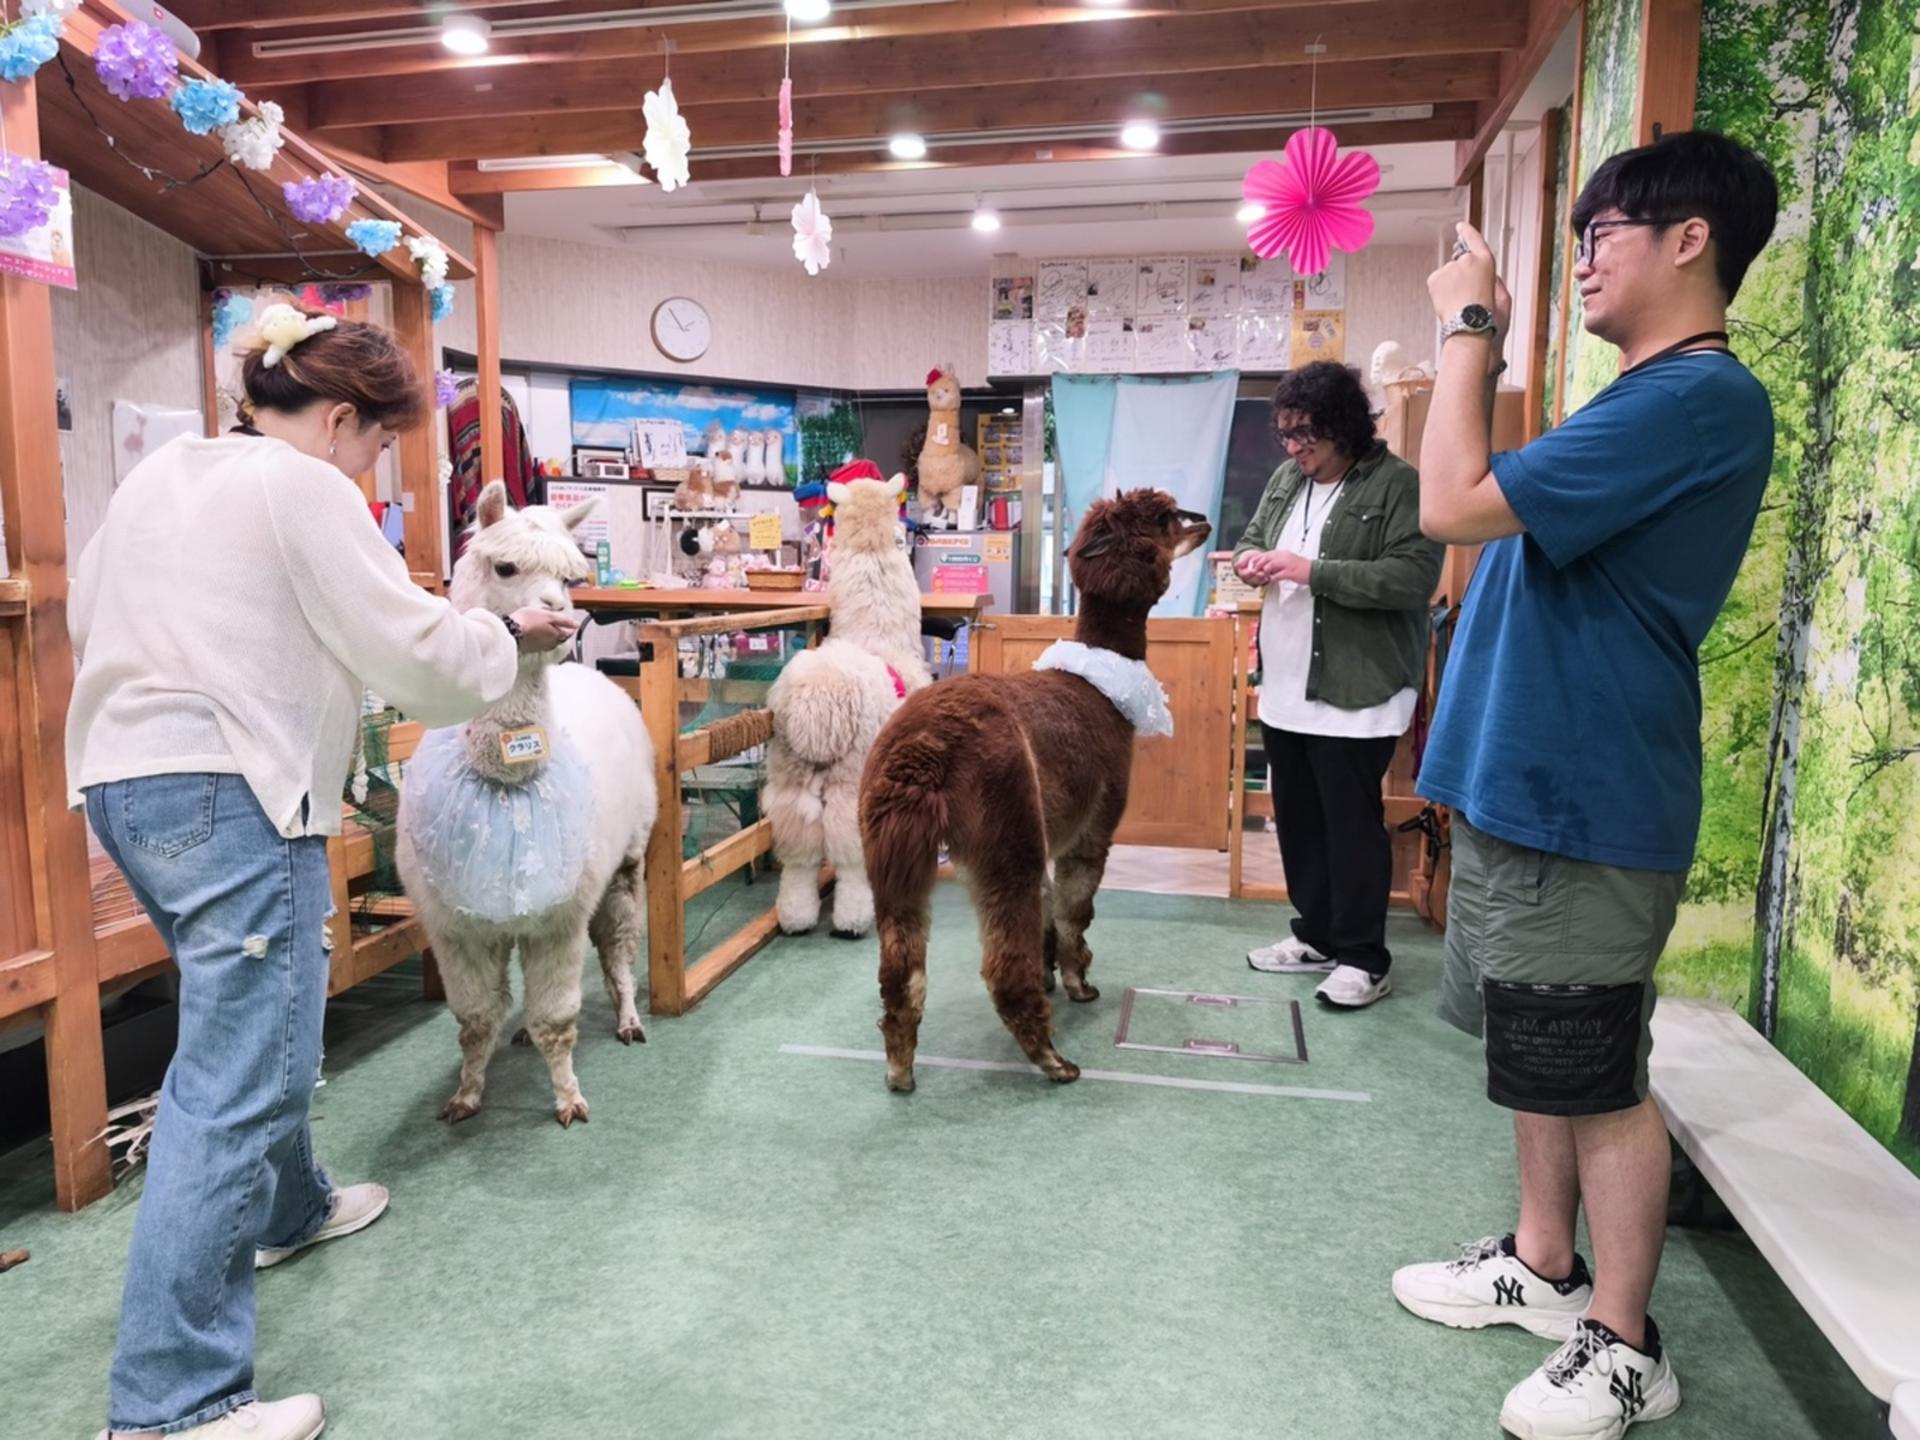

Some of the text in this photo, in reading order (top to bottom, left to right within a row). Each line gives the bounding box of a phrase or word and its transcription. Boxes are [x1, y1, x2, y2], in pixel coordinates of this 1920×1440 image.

[509, 740, 541, 753] クラリス
[1492, 1274, 1528, 1307] NY
[1608, 1364, 1646, 1426] NY
